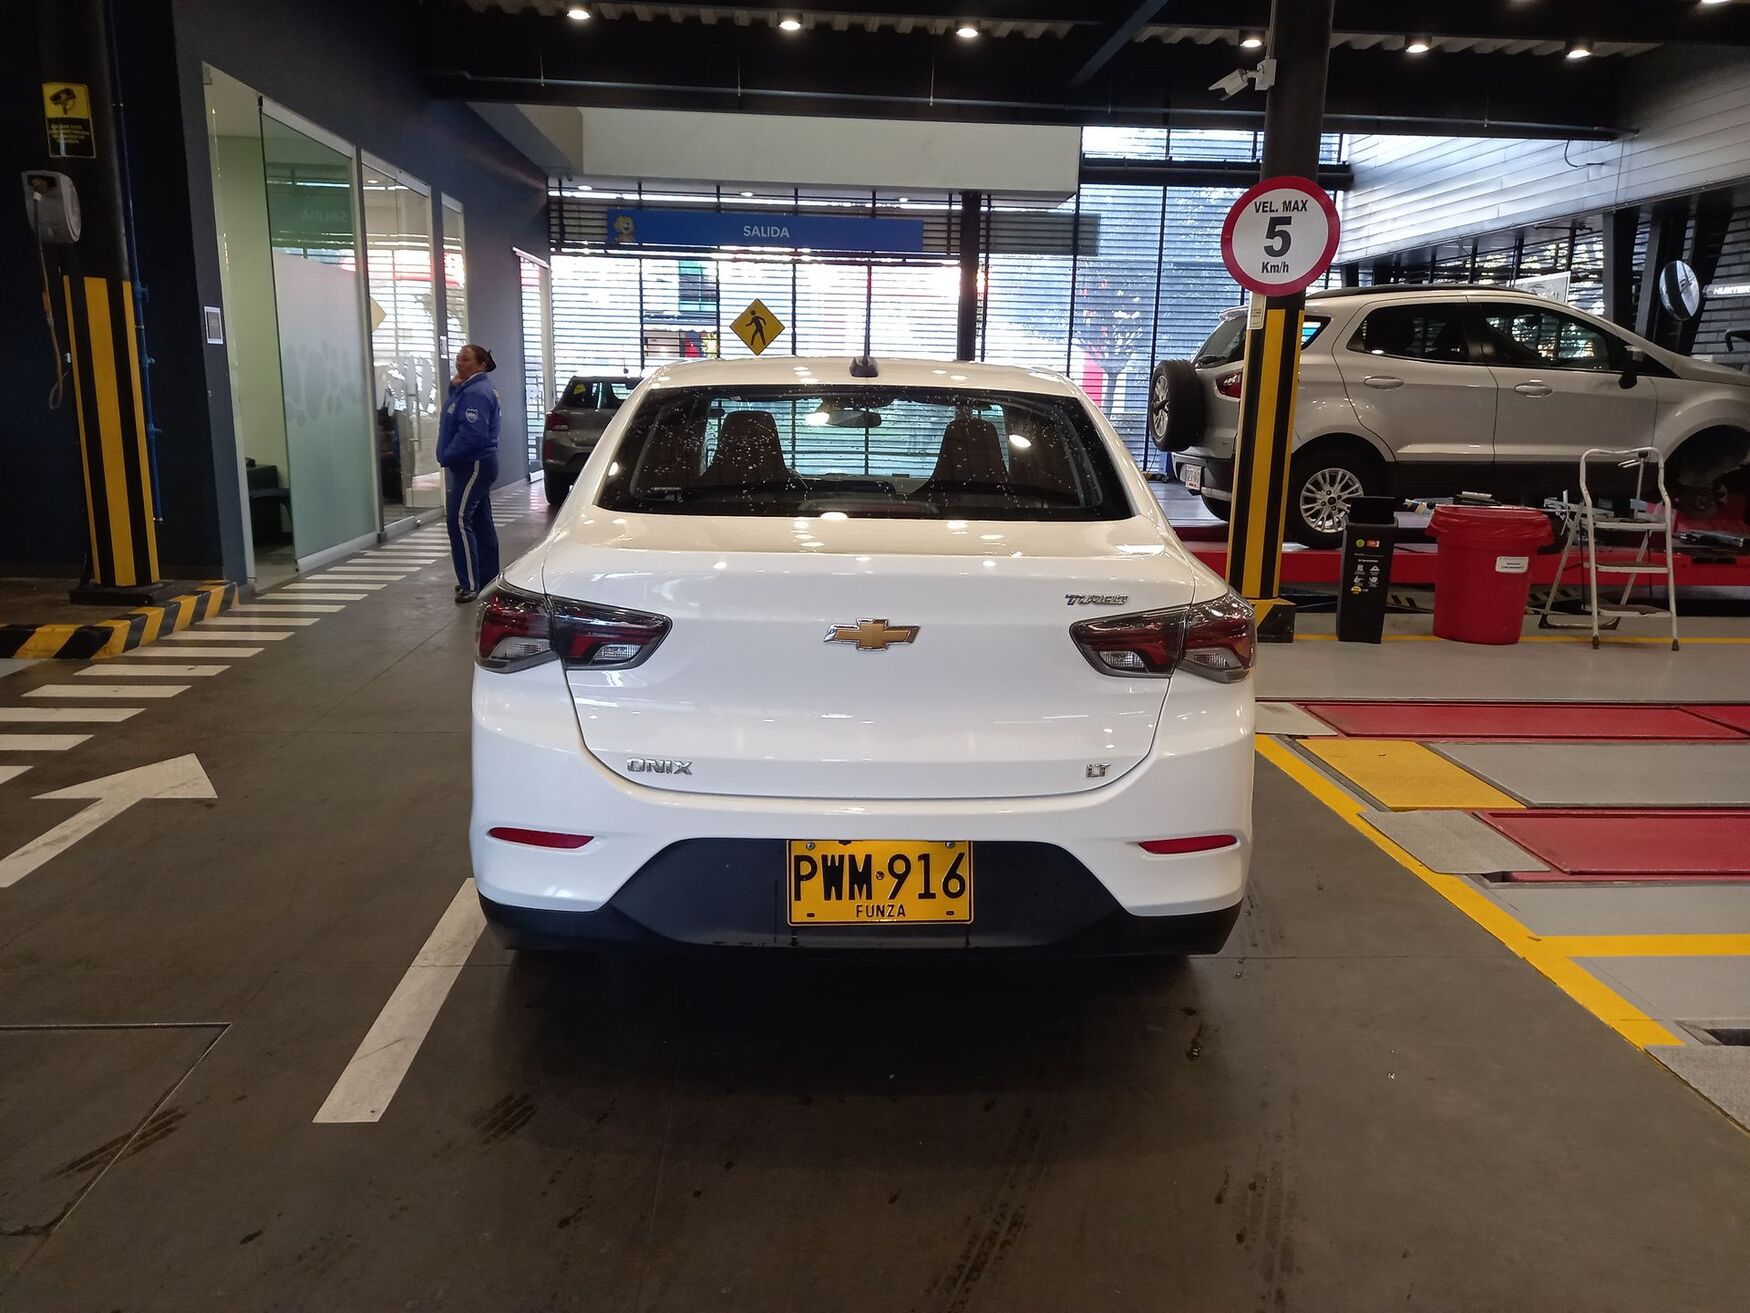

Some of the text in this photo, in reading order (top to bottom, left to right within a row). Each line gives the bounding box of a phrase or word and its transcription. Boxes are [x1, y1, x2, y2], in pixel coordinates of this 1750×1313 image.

[1254, 200, 1309, 213] VEL. MAX
[743, 225, 790, 238] SALIDA
[1263, 216, 1292, 257] 5
[1261, 261, 1290, 273] Km/h
[1065, 594, 1128, 606] TURBO
[626, 758, 693, 775] ONIX
[1086, 763, 1110, 777] LT
[855, 903, 906, 918] FUNZA
